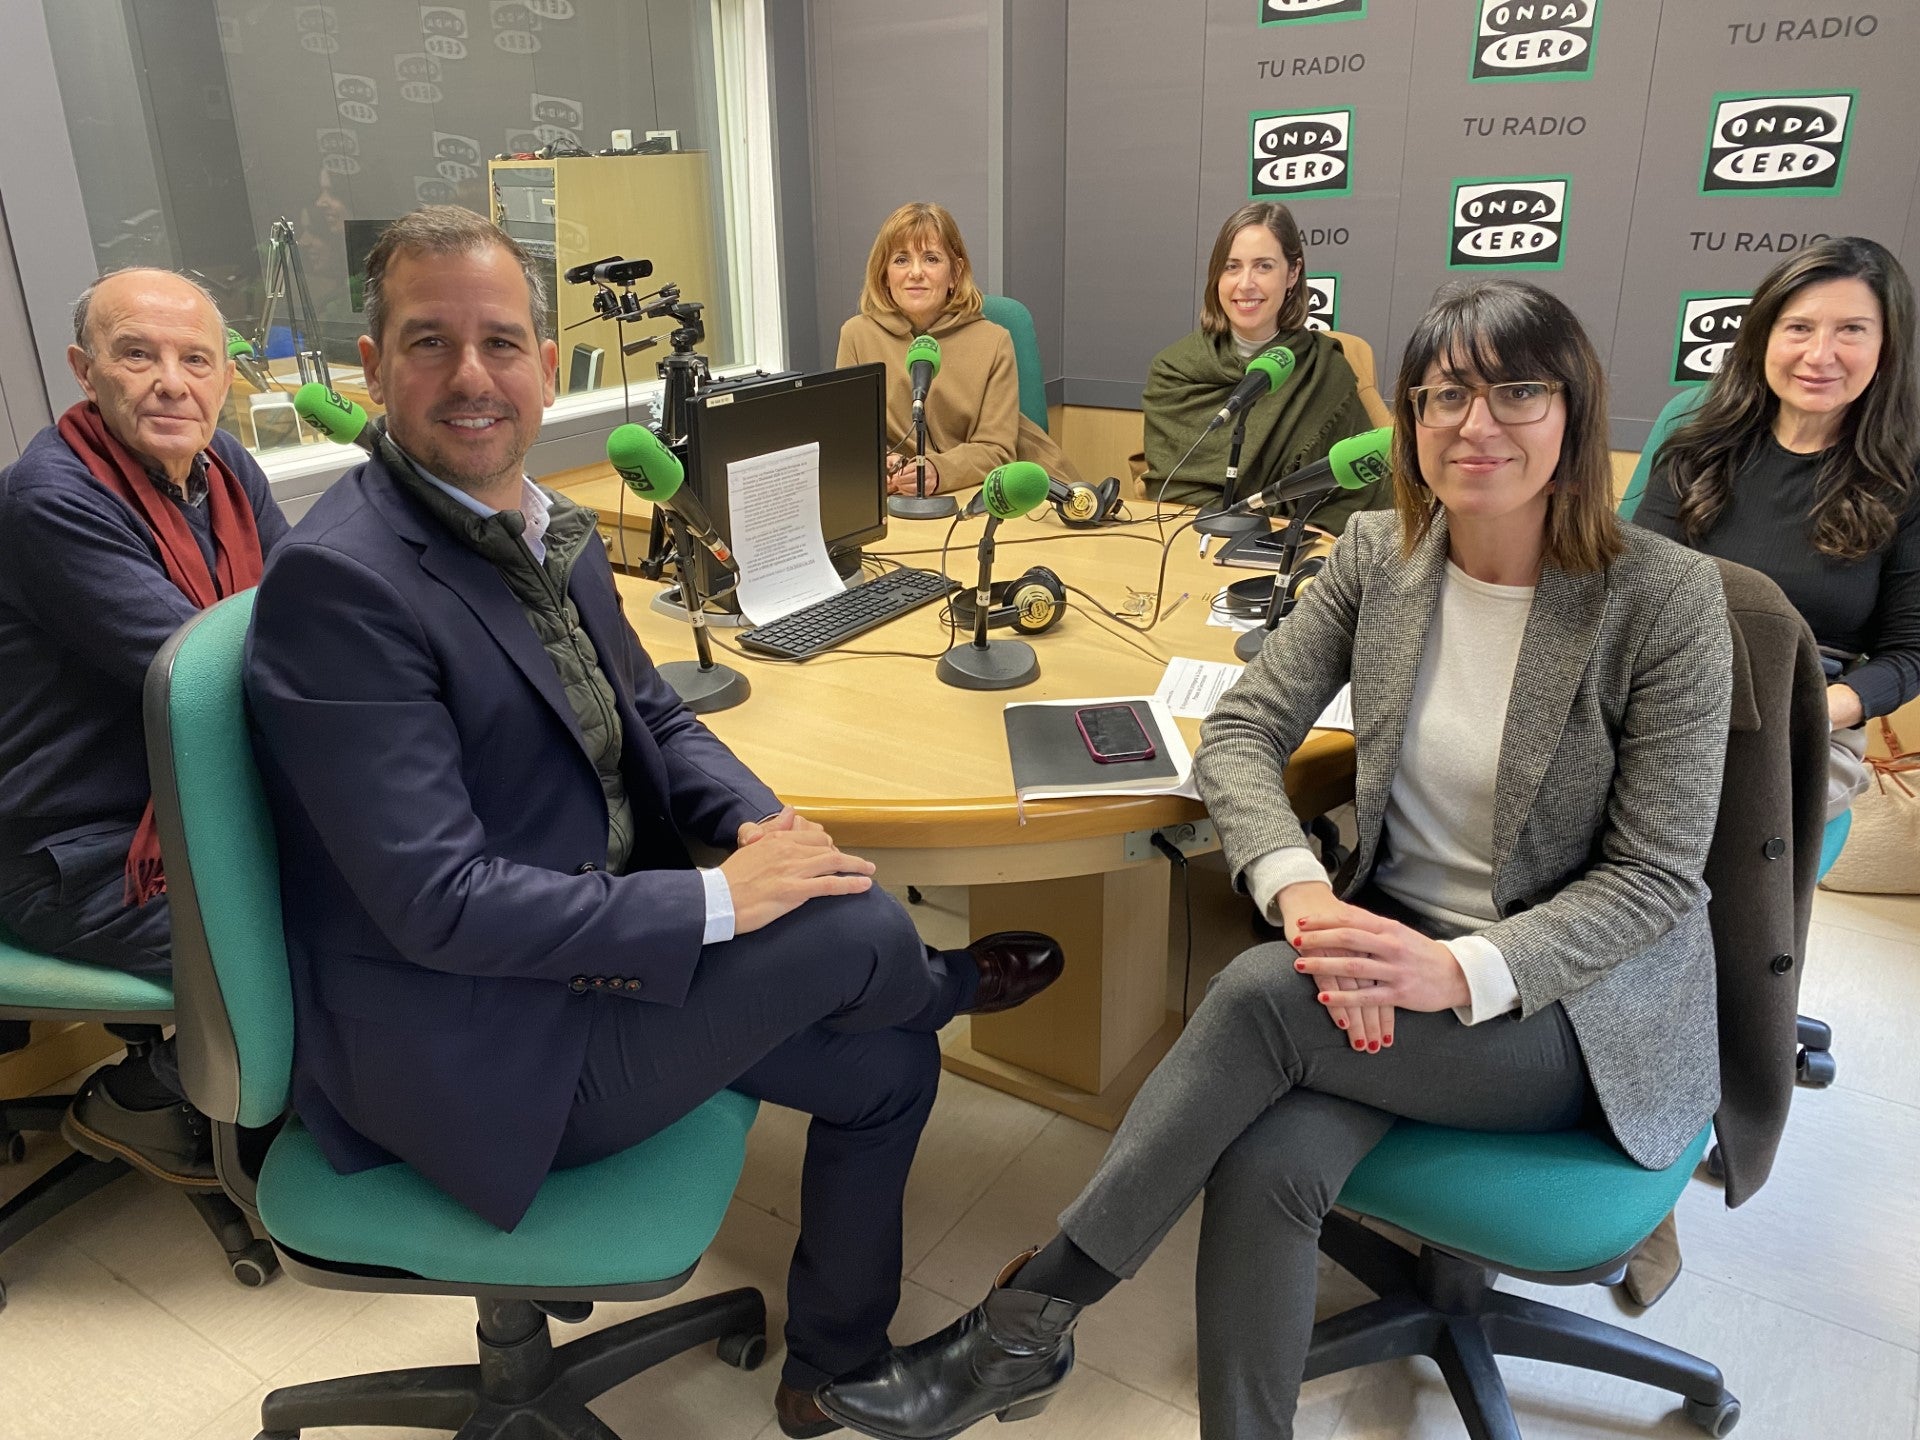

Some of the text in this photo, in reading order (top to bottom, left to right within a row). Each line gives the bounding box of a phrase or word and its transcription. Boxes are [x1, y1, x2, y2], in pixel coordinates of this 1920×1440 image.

[1495, 3, 1577, 25] ONDA
[1728, 15, 1878, 45] TU RADIO
[1496, 39, 1573, 60] CERO
[1258, 53, 1366, 79] TU RADIO
[1463, 116, 1587, 136] TU RADIO
[1731, 116, 1825, 137] ONDA
[1266, 130, 1334, 149] ONDA
[1269, 161, 1333, 180] CERO
[1731, 152, 1819, 173] CERO
[1469, 199, 1547, 218] ONDA
[1299, 227, 1350, 247] ADIO
[1471, 231, 1544, 250] CERO
[1690, 231, 1726, 251] TU
[1700, 315, 1742, 333] ON
